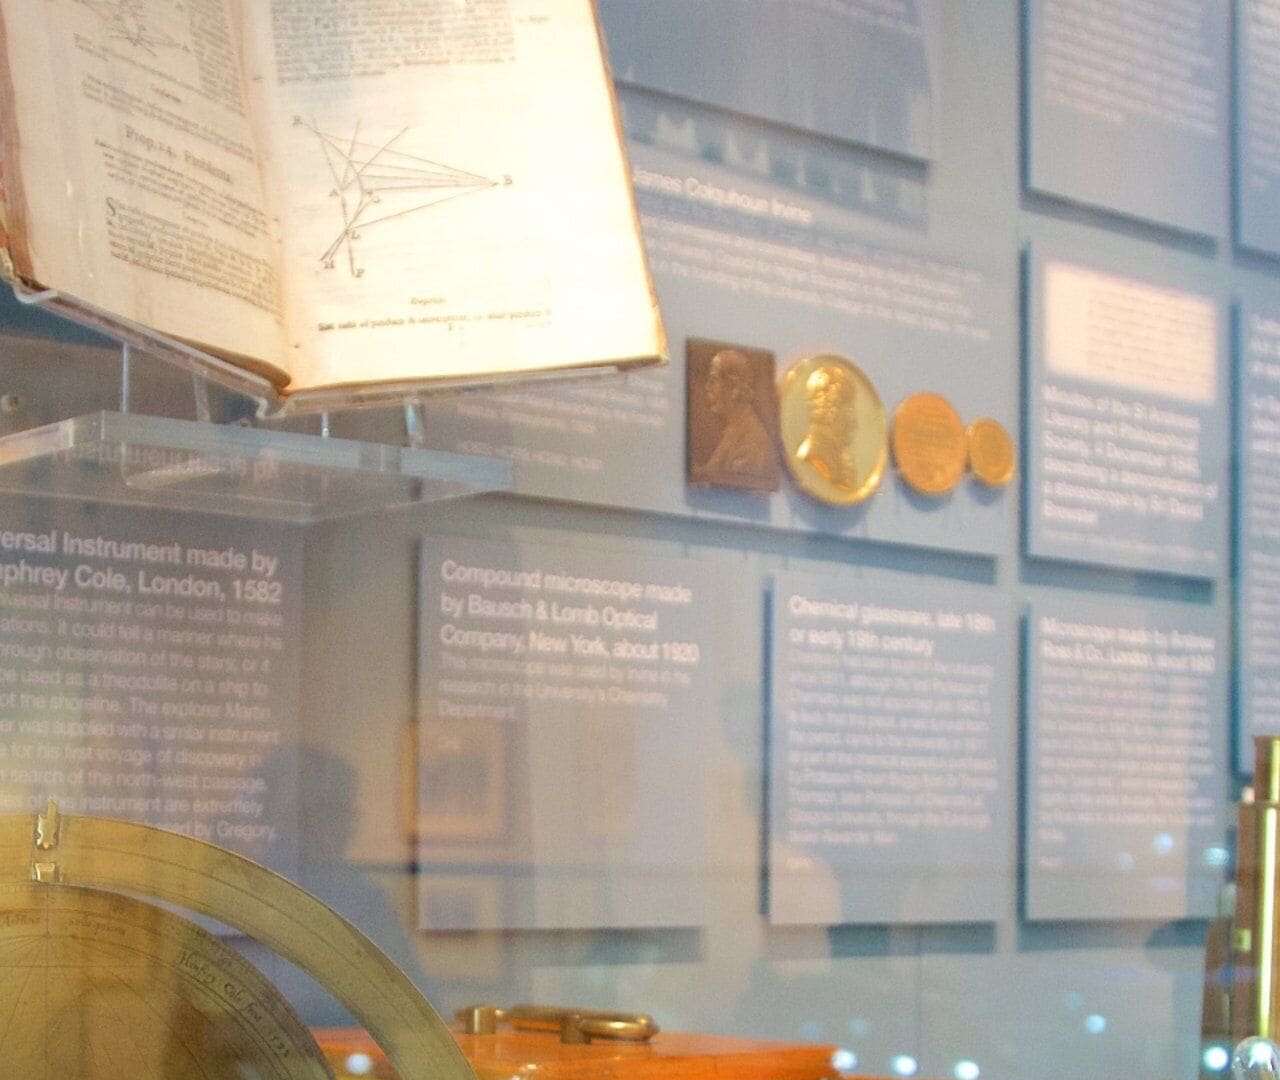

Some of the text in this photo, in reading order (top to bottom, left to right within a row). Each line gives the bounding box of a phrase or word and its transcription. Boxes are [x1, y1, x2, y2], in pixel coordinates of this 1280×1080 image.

[63, 531, 181, 562] Instrument
[187, 545, 246, 568] made
[252, 548, 277, 575] by
[233, 578, 282, 602] 1582
